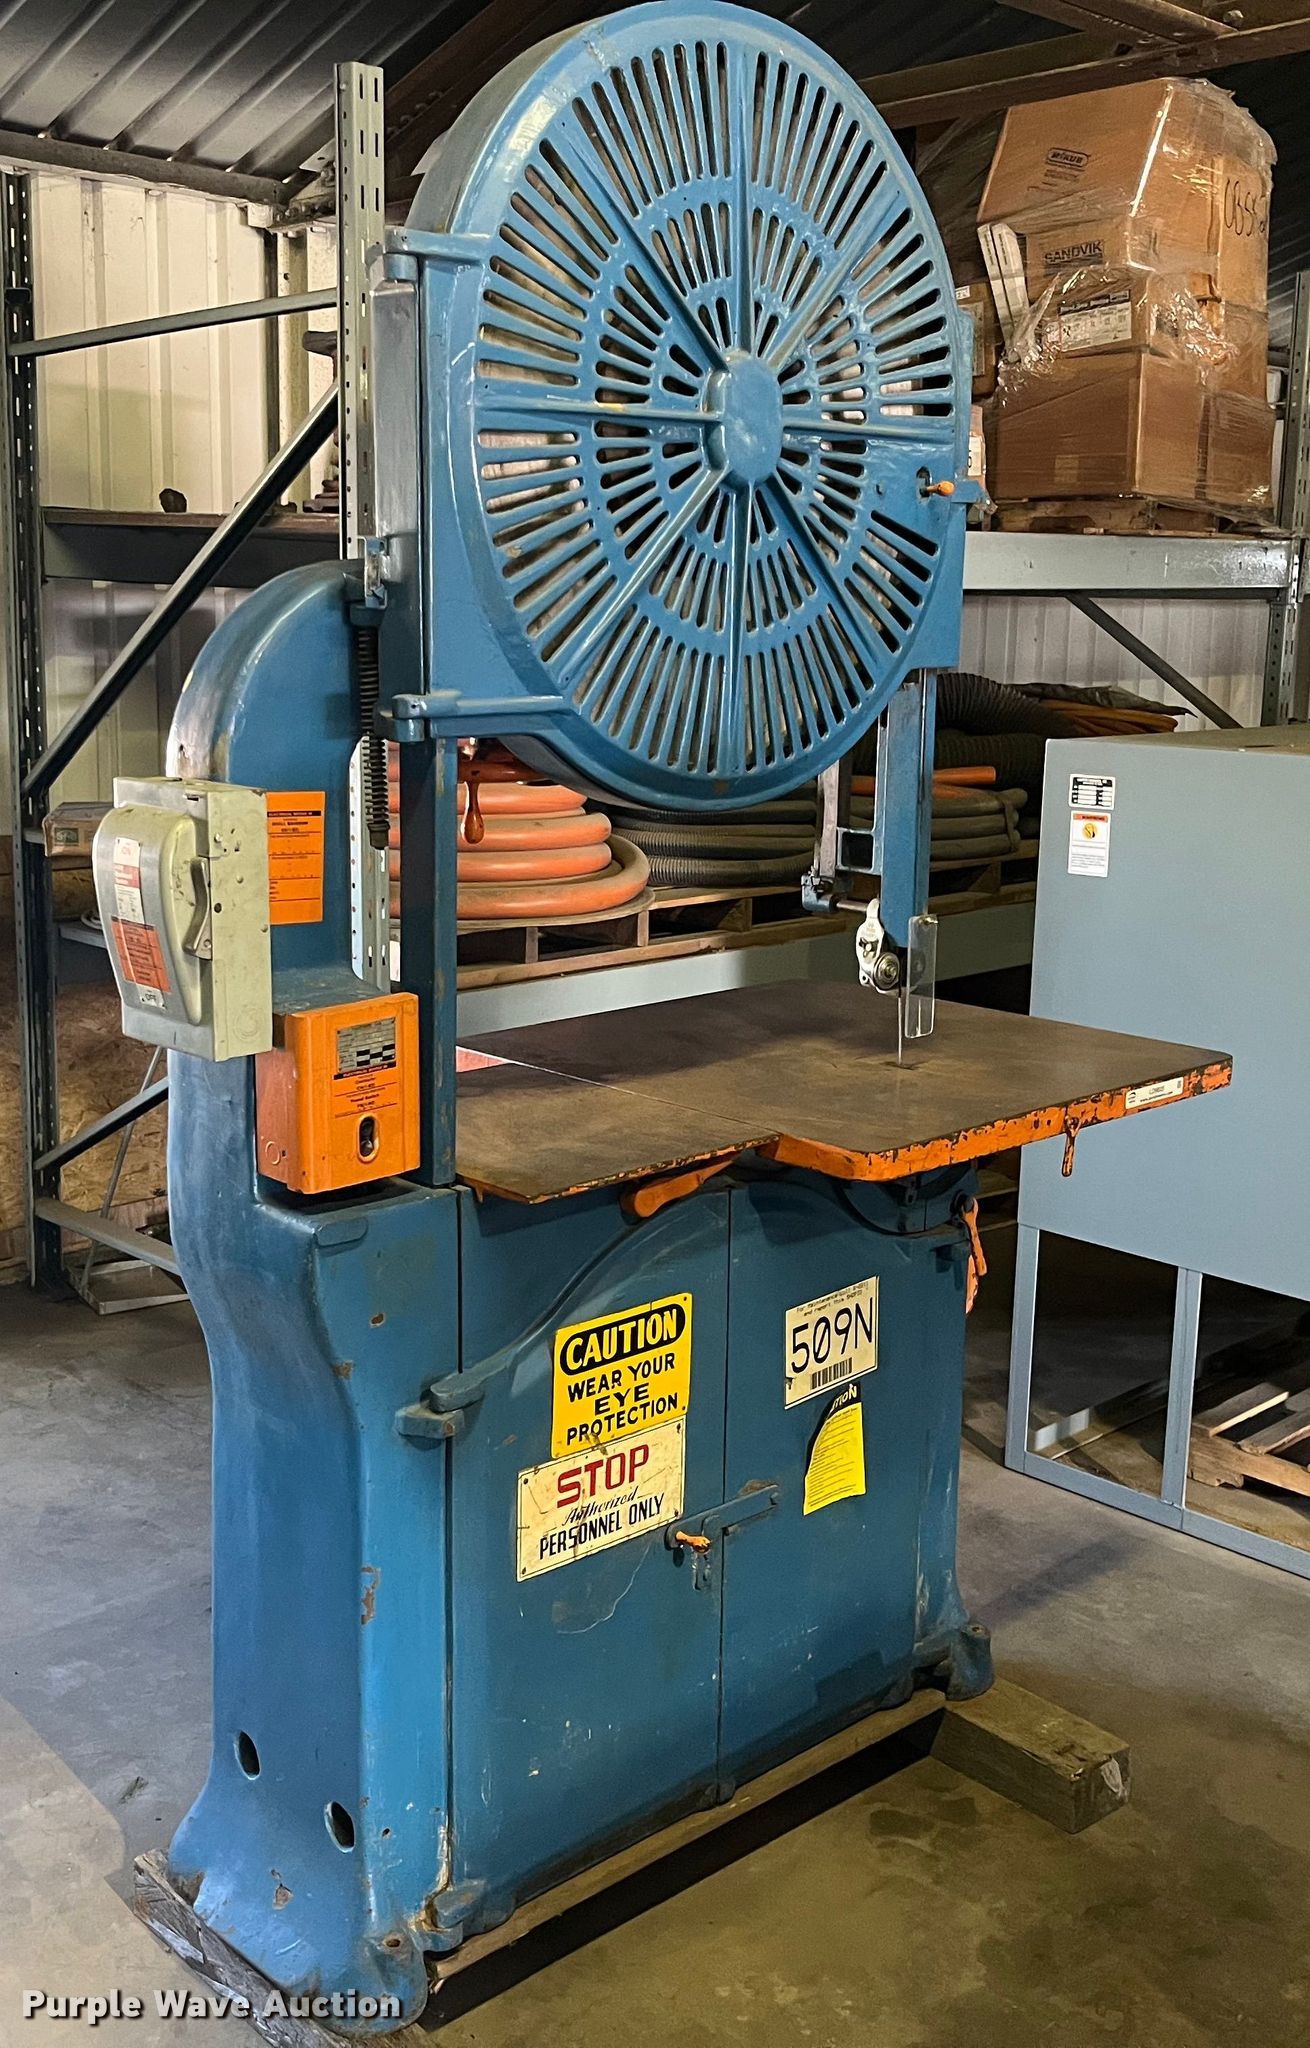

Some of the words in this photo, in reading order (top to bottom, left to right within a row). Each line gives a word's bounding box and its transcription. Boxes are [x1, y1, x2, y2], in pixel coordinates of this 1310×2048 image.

[1045, 241, 1103, 263] SANDVIK
[566, 1308, 677, 1370] CAUTION
[791, 1297, 873, 1374] 509N
[567, 1369, 622, 1403] WEAR
[628, 1352, 675, 1381] YOUR
[595, 1383, 649, 1416] EYE
[567, 1392, 678, 1446] PROTECTION
[557, 1444, 649, 1508] STOP
[539, 1510, 622, 1560] PERSONNEL
[629, 1493, 665, 1525] ONLY
[562, 1485, 639, 1526] Authorized
